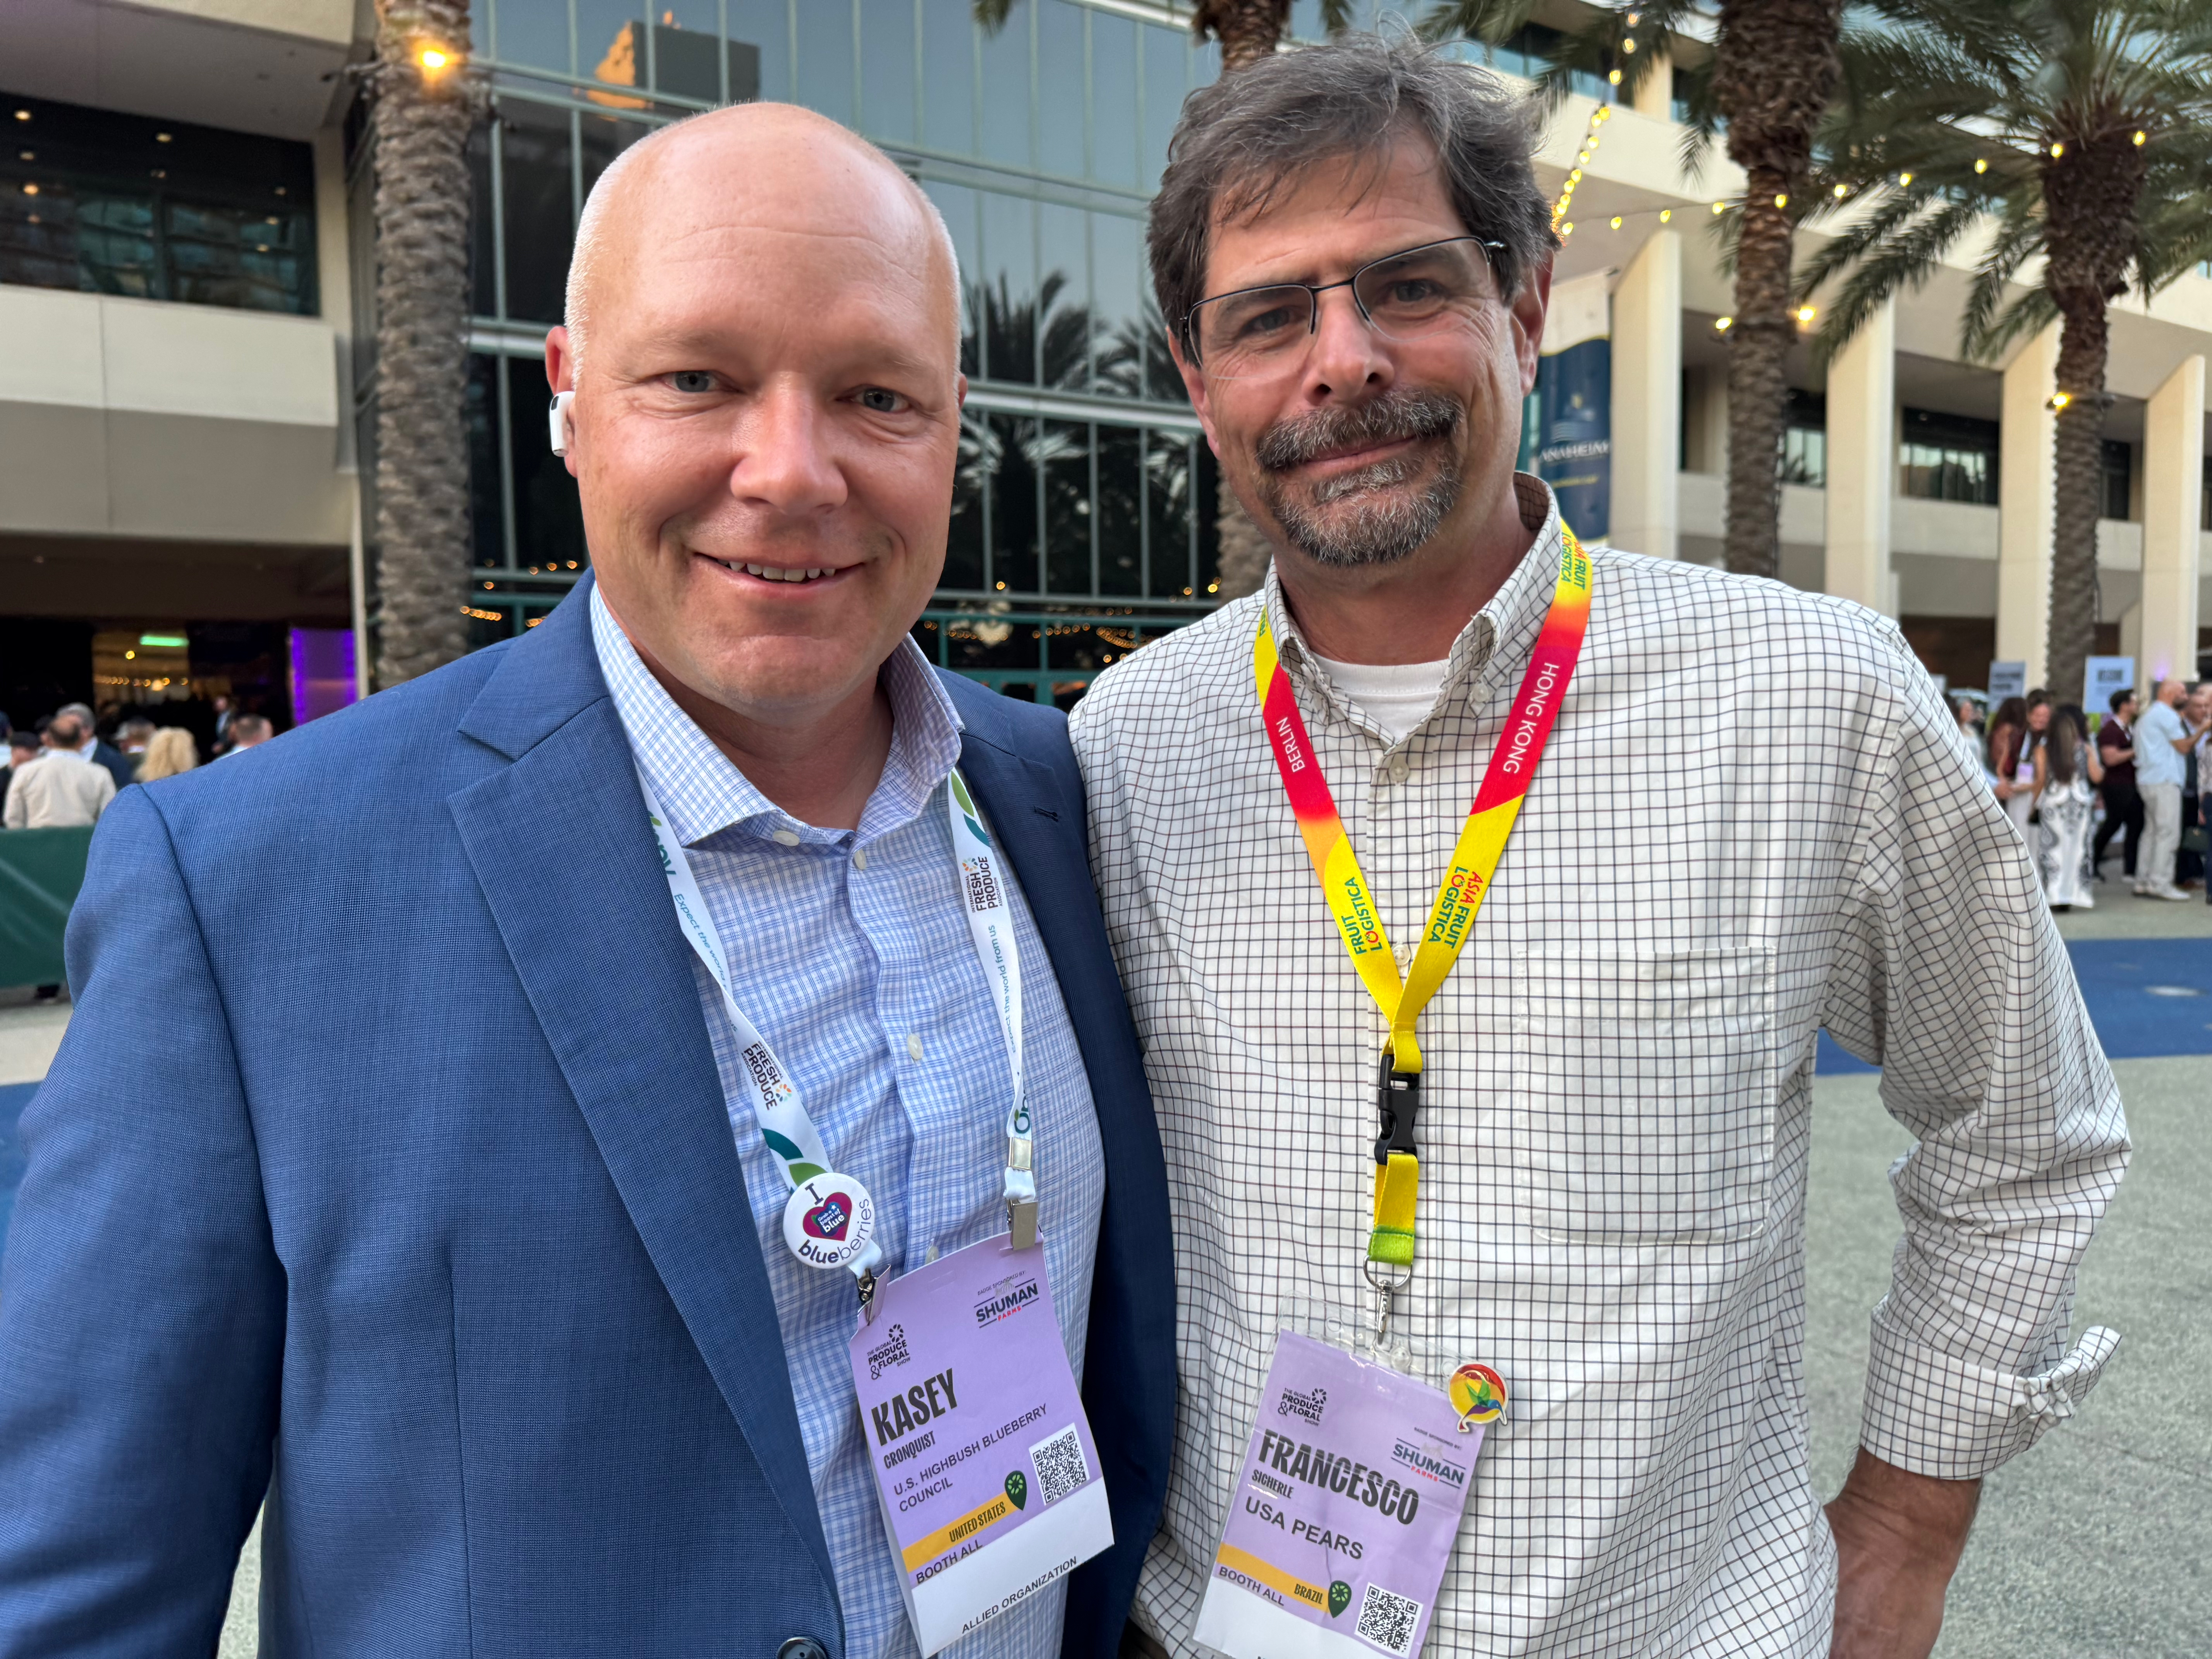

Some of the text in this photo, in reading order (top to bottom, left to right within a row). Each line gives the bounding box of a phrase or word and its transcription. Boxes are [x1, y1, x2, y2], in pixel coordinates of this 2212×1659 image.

[1574, 558, 1586, 590] FRUIT
[1503, 662, 1560, 774] HONG KONG
[1276, 716, 1305, 773] BERLIN
[970, 872, 987, 911] FRESH
[978, 856, 998, 909] PRODUCE
[1345, 876, 1382, 951] LOGISTICA
[1428, 866, 1468, 942] LOGISTICA
[1444, 871, 1483, 949] ASIA FRUIT
[674, 894, 725, 981] Expect the world
[988, 925, 996, 937] us
[992, 938, 1003, 963] from
[1341, 915, 1367, 955] FRUIT
[998, 965, 1009, 994] world
[1006, 1015, 1016, 1053] Expect
[744, 1048, 777, 1111] PRODUCE
[751, 1043, 780, 1086] FRESH
[805, 1183, 824, 1206] I
[798, 1199, 871, 1264] blueberries
[823, 1214, 844, 1233] blue
[976, 1283, 1038, 1322] SHUMAN
[998, 1305, 1022, 1321] FARMS
[868, 1340, 907, 1365] PRODUCE
[875, 1341, 892, 1352] GLOBAL
[878, 1349, 909, 1369] FLORAL
[896, 1357, 910, 1366] SHOW
[871, 1368, 957, 1446] KASEY
[1282, 1393, 1324, 1413] PRODUCE
[1289, 1404, 1320, 1422] FLORAL
[883, 1431, 936, 1469] CRONQUIST
[894, 1403, 1047, 1495] U.S. HIGHBUSH BLUEBERRY
[1393, 1444, 1464, 1484] SHUMAN
[1252, 1469, 1293, 1499] SICHERLE
[1258, 1428, 1419, 1525] FRANCESCO
[1411, 1465, 1438, 1482] FARMS
[899, 1477, 953, 1512] COUNCIL
[949, 1501, 1006, 1542] UNITED STATES
[1246, 1496, 1363, 1559] USA PEARS
[916, 1539, 983, 1584] BOOTH ALL
[962, 1556, 1077, 1634] ALLIED ORGANIZATION
[1219, 1566, 1284, 1606] BOOTH ALL
[1294, 1583, 1323, 1604] BRAZIL
